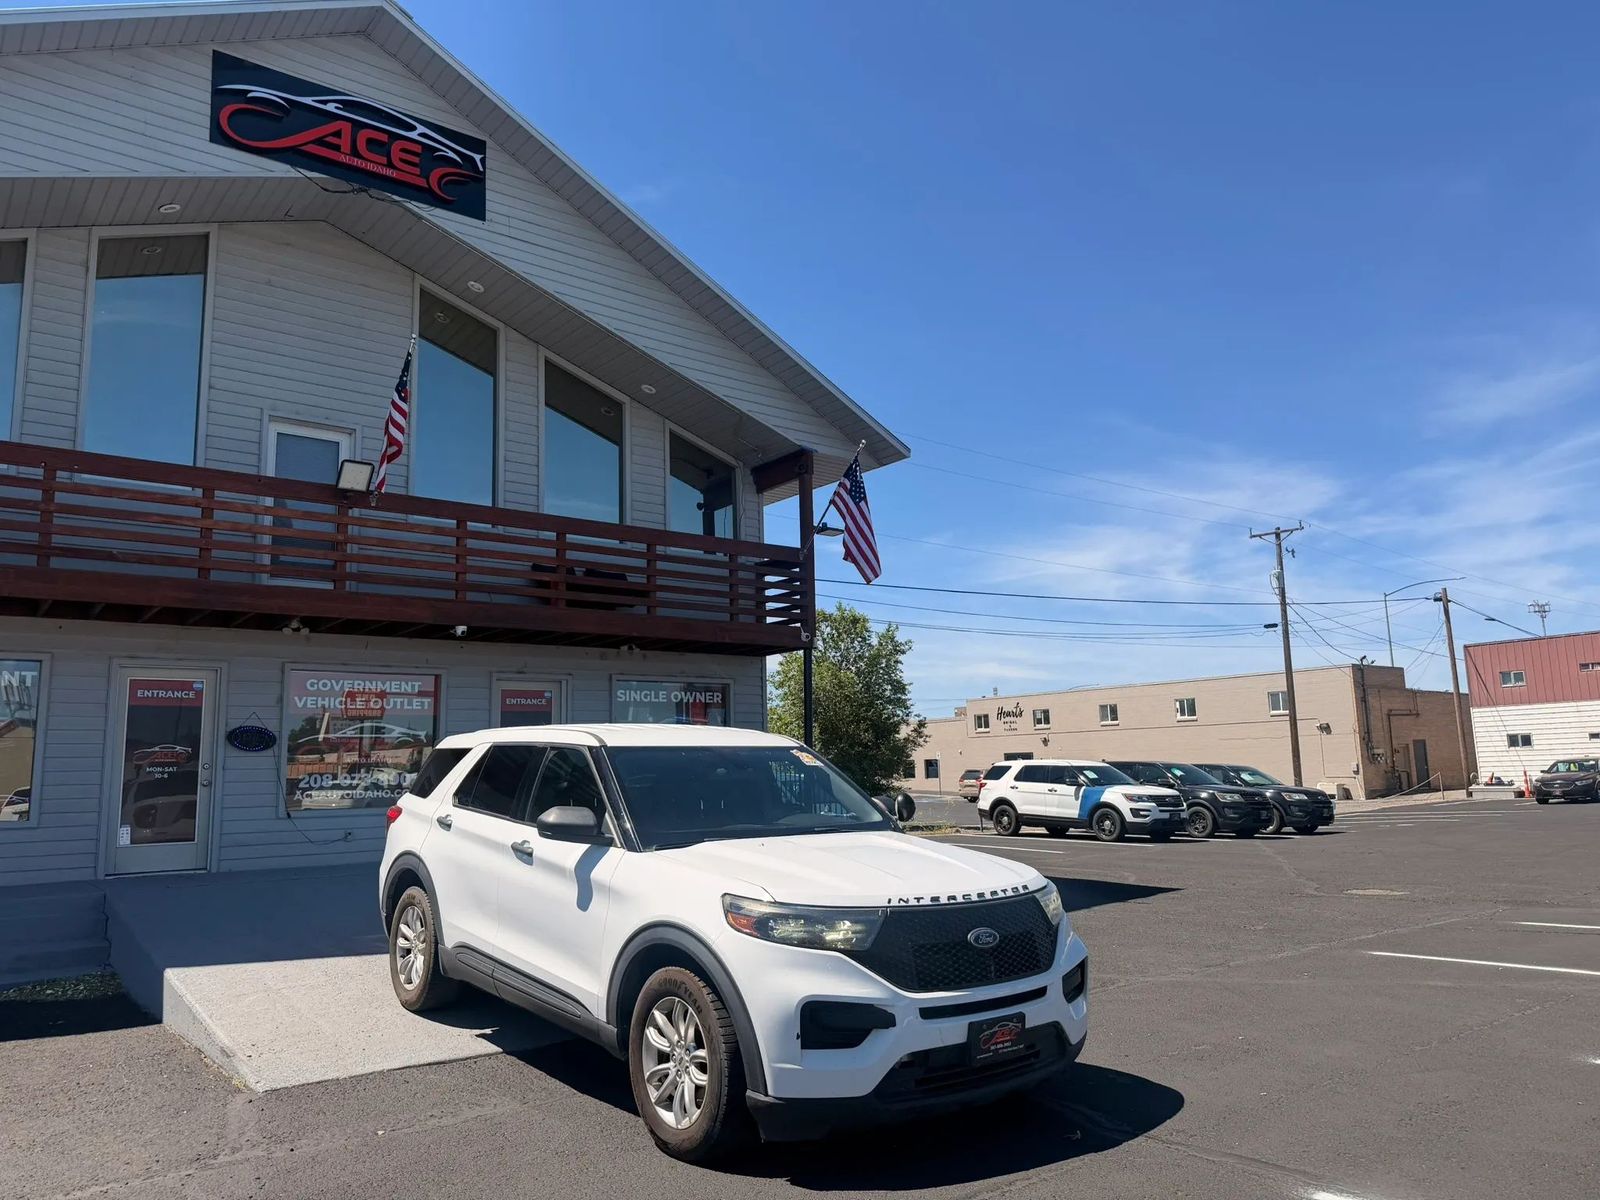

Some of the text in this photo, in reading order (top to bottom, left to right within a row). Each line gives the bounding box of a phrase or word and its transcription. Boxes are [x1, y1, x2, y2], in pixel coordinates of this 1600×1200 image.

[306, 679, 422, 692] GOVERNMENT
[137, 689, 196, 699] ENTRANCE
[616, 689, 722, 704] SINGLE OWNER
[294, 697, 432, 710] VEHICLE OUTLET
[887, 884, 1030, 904] INTERCEPTOR
